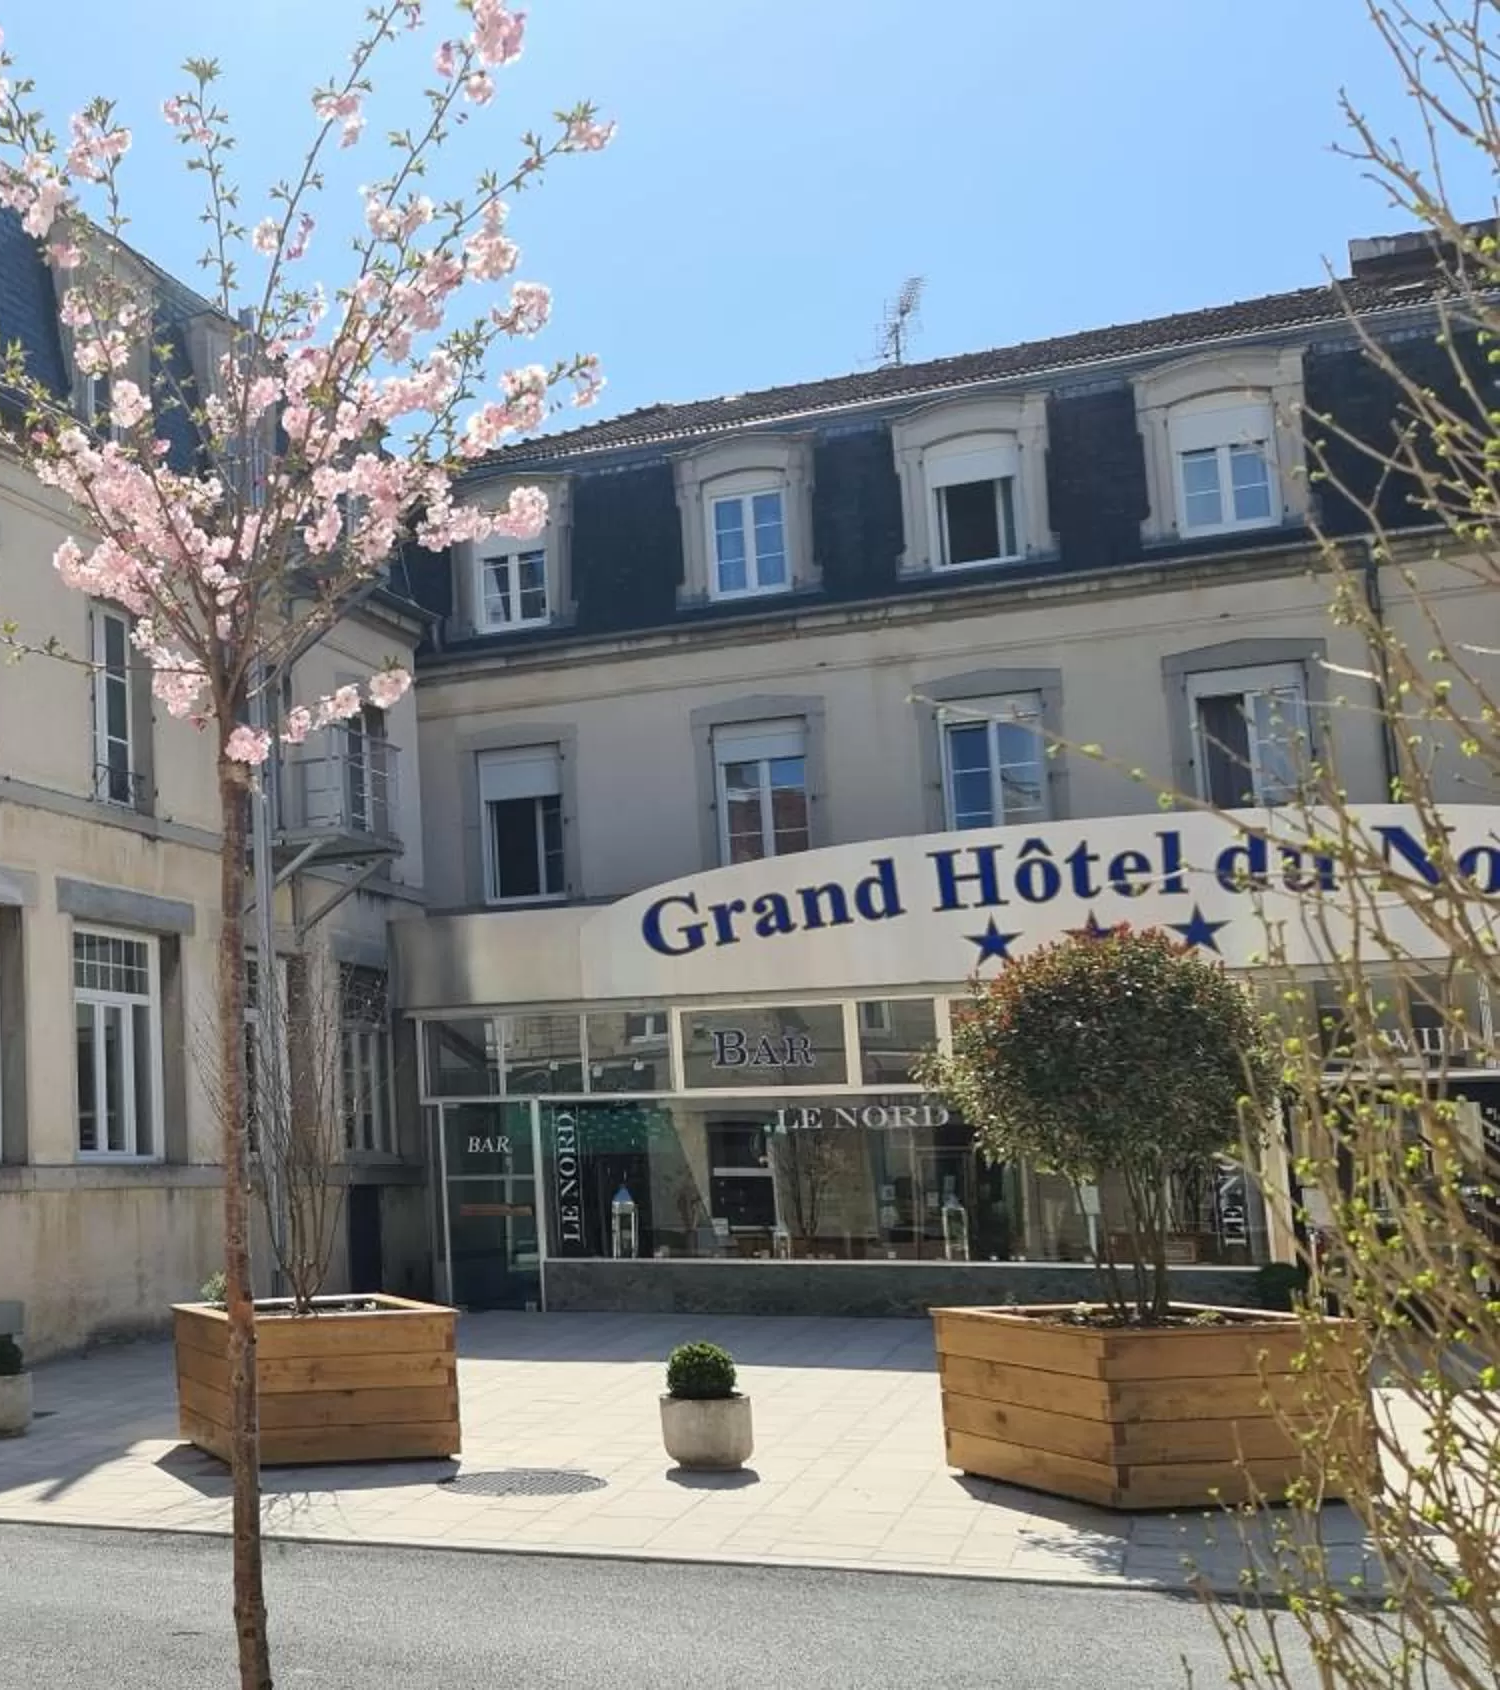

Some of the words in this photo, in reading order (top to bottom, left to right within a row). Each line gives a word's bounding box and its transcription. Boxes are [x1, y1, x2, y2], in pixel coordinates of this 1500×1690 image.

[641, 857, 907, 956] Grand
[925, 830, 1189, 912] Hôtel
[1215, 827, 1340, 894] du
[776, 1107, 823, 1130] LE
[835, 1104, 949, 1130] NORD
[467, 1135, 510, 1154] BAR
[557, 1112, 578, 1198] NORD
[562, 1204, 581, 1243] LE
